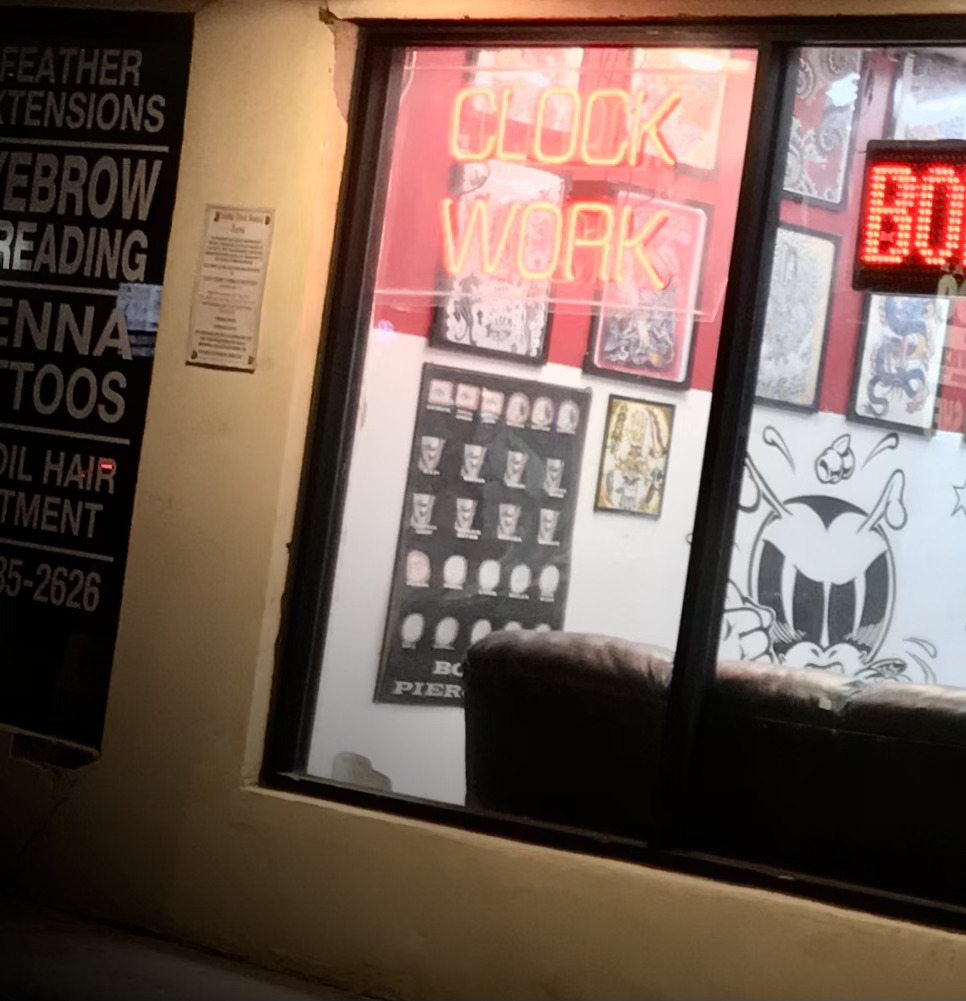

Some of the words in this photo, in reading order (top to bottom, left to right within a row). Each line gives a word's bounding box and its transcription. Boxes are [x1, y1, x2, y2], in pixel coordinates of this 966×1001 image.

[0, 45, 143, 86] FEATHER
[0, 88, 166, 134] TENSIONS
[452, 87, 681, 167] CLOCK
[0, 149, 164, 222] EBROW
[441, 197, 671, 290] WORK
[0, 359, 128, 425] TOOS
[42, 449, 117, 495] HAIR
[392, 680, 466, 698] PIER
